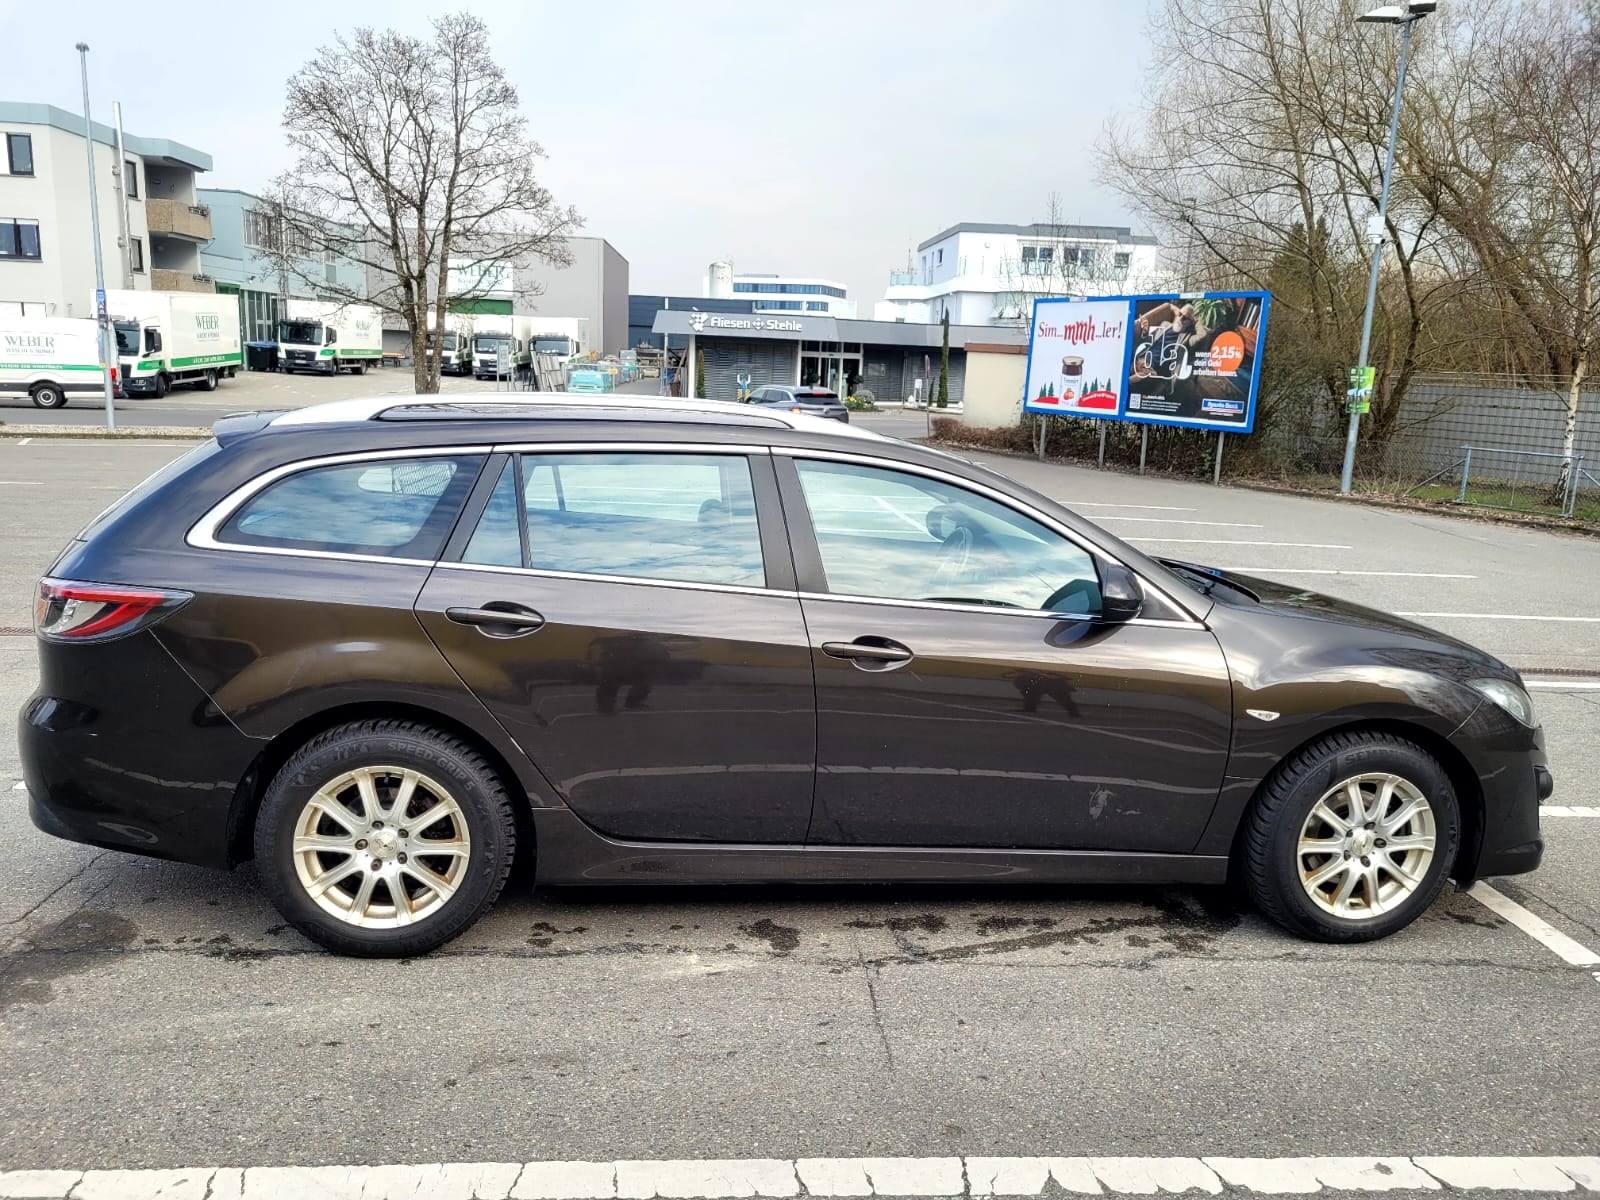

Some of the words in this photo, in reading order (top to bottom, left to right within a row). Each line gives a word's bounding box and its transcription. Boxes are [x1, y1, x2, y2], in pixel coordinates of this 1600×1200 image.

[195, 315, 219, 330] WEBER
[710, 316, 751, 329] Fliesen
[766, 319, 803, 331] Stehle
[4, 335, 55, 348] WEBER
